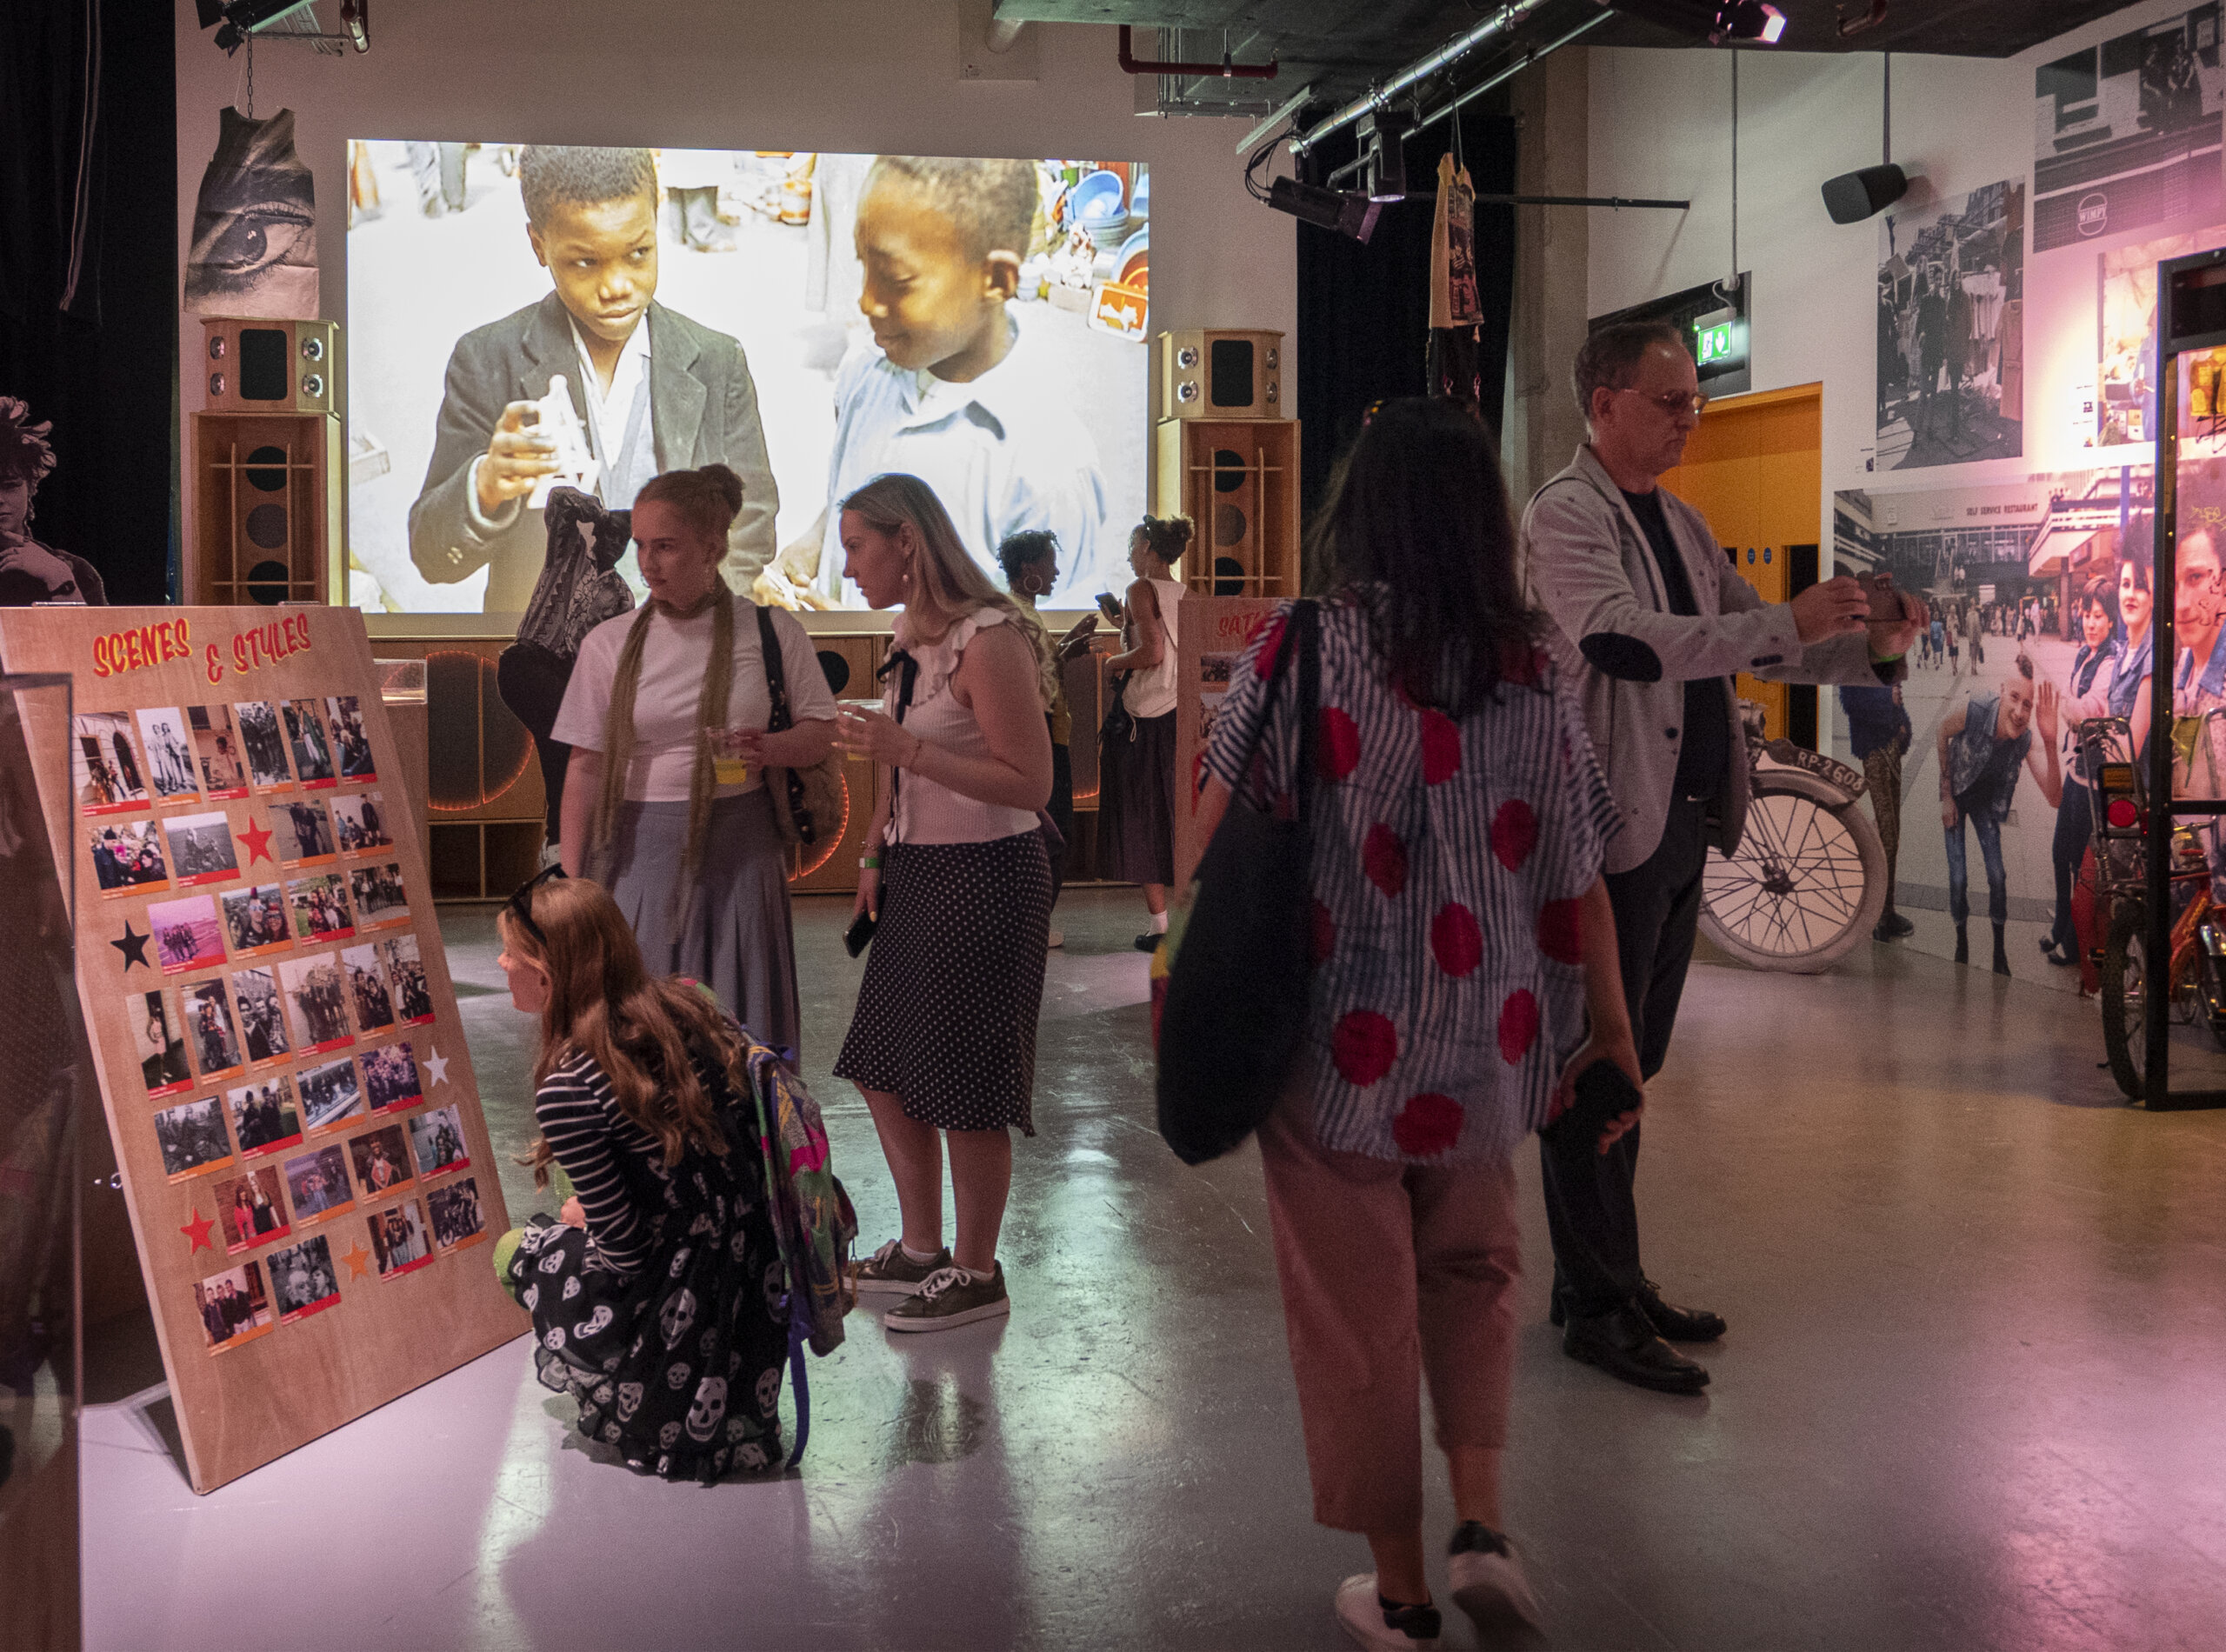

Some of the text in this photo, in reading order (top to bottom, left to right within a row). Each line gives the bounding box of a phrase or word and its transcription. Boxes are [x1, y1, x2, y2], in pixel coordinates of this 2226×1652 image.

[2079, 206, 2106, 223] WIMPY
[1966, 503, 2038, 516] SELF SERVICE RESTAURANT
[93, 617, 192, 677] SCENES
[233, 612, 311, 675] STYLES
